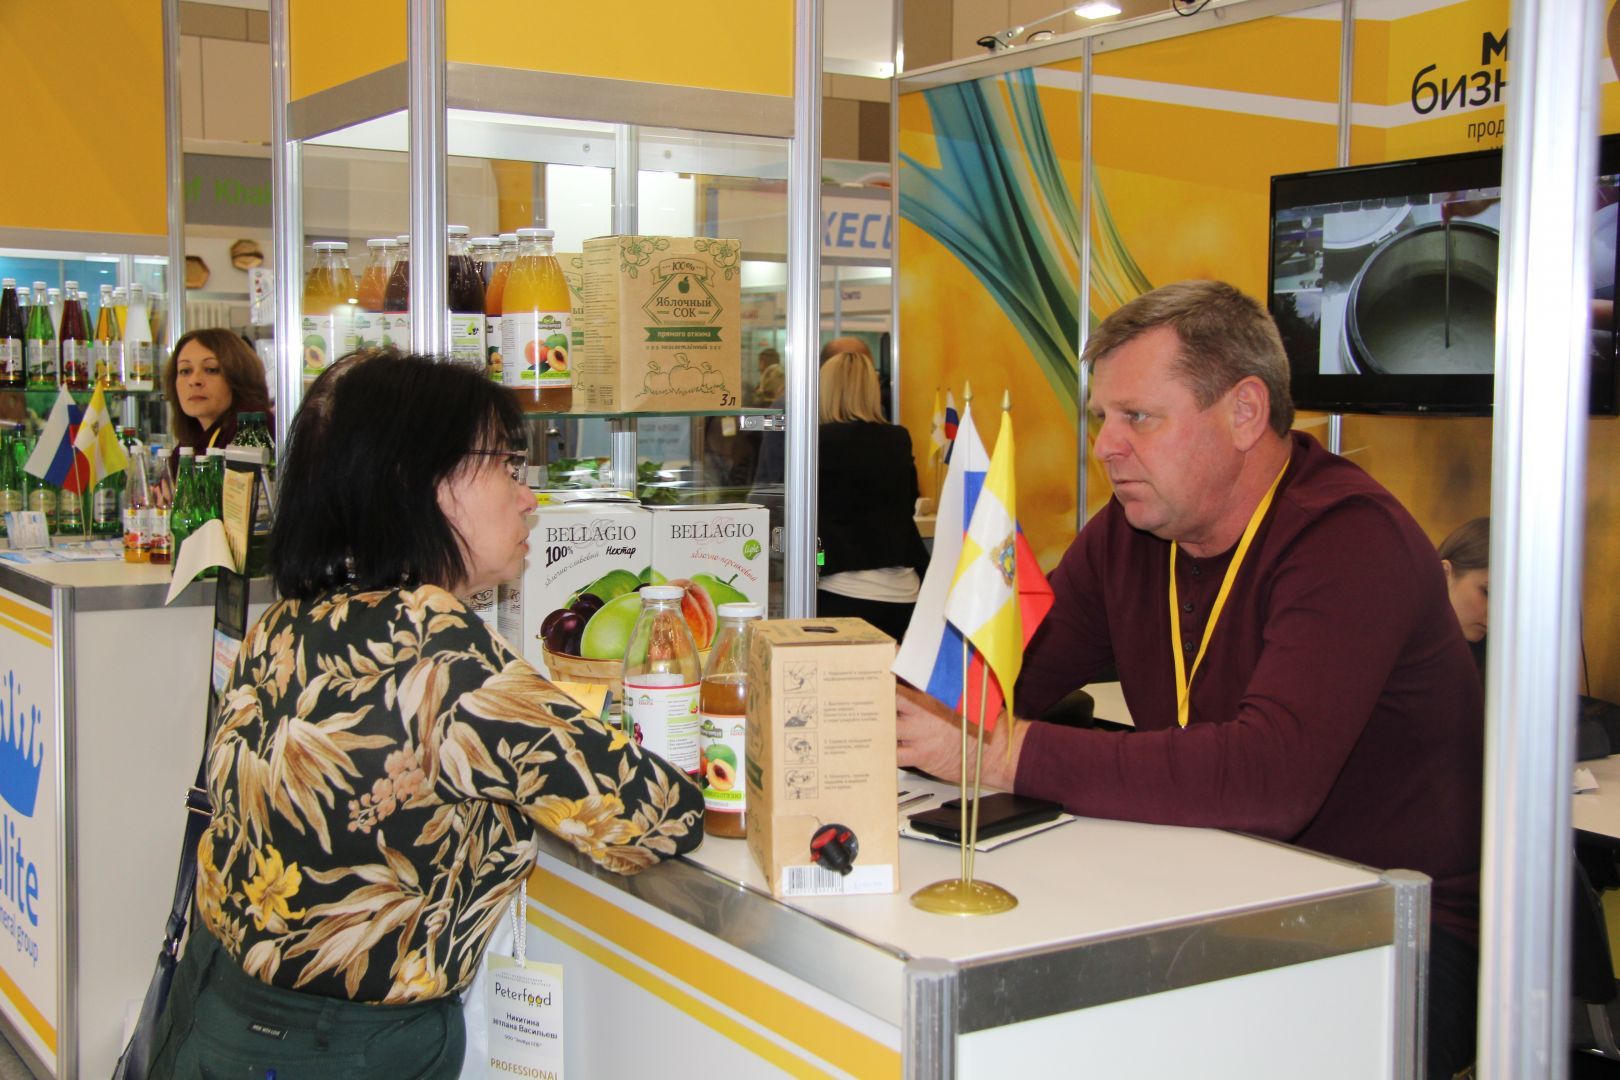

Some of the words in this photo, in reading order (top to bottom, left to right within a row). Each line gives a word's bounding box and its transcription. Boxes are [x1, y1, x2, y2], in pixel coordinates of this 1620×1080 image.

[655, 296, 713, 308] Яблочный
[673, 307, 697, 318] СОК
[720, 393, 728, 406] 3
[546, 526, 637, 543] BELLAGIO
[671, 523, 754, 539] BELLAGIO
[545, 545, 574, 568] 100%
[605, 545, 637, 559] Нектар
[0, 813, 38, 928] lite
[495, 981, 552, 1007] Peterfood
[506, 1012, 540, 1027] Никитина
